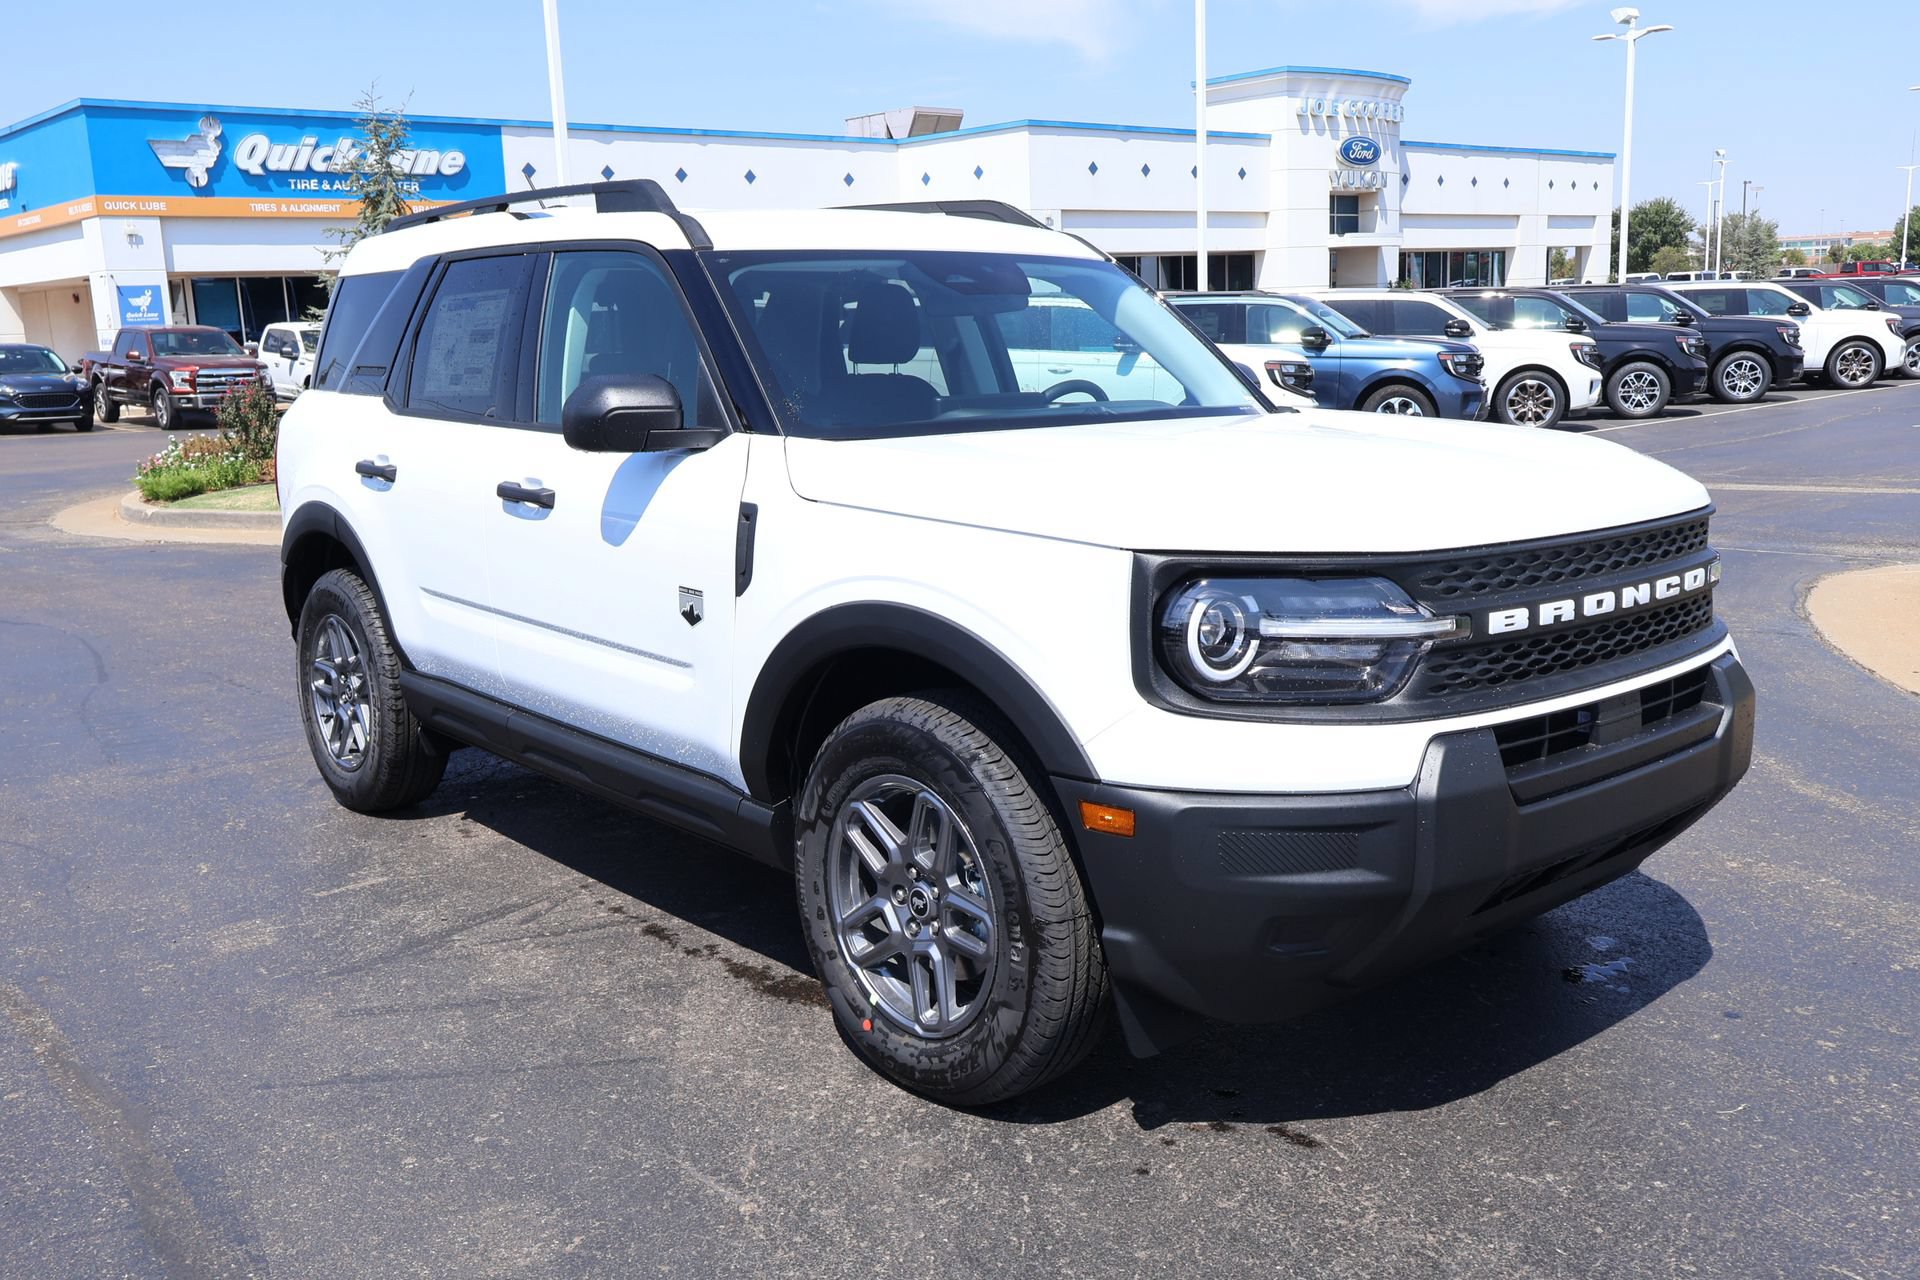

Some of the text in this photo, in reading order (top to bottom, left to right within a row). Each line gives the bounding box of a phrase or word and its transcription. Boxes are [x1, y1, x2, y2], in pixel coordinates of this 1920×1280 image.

[1297, 97, 1404, 121] JOE COOPER
[234, 132, 364, 176] Quick
[1349, 141, 1375, 160] Ford
[288, 179, 318, 191] TIRE
[322, 180, 331, 190] &
[333, 181, 367, 193] AU
[1331, 170, 1388, 188] YUKON
[104, 201, 137, 211] QUICK
[139, 201, 168, 211] LUBE
[249, 203, 341, 213] TIRES & ALIGNMENT
[1488, 568, 1705, 635] BRONCO
